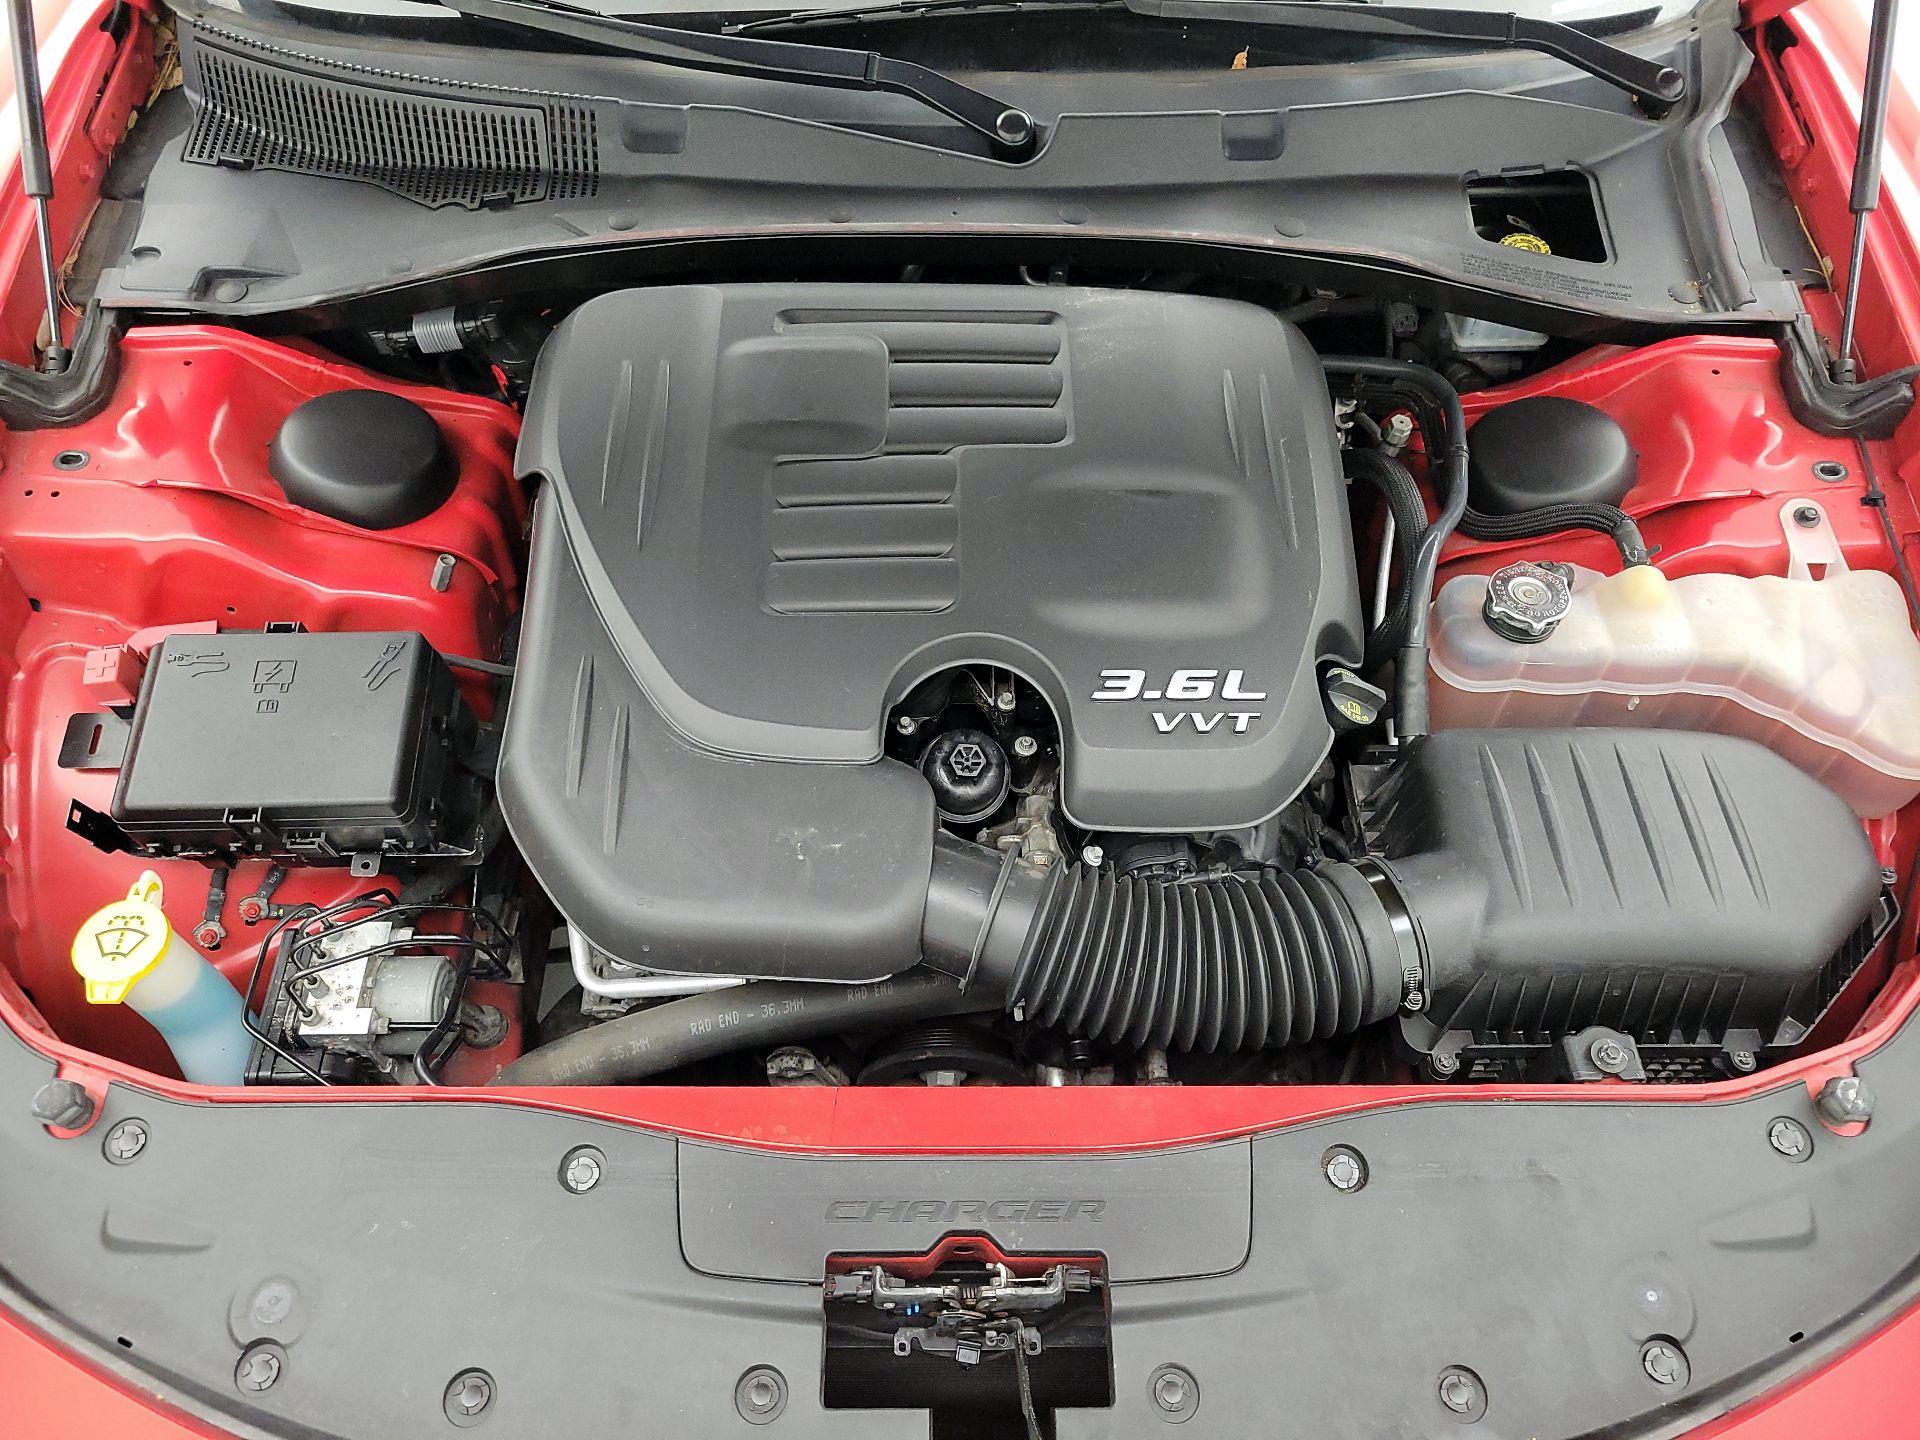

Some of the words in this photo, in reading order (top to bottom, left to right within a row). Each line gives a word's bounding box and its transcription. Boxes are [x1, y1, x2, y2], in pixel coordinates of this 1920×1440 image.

[1090, 669, 1268, 701] 3.6L
[1151, 712, 1261, 735] VVT
[874, 982, 894, 998] END
[690, 1018, 712, 1036] RAD
[718, 1010, 741, 1028] END
[760, 997, 806, 1019] 36.3MM
[824, 1199, 1107, 1224] CHARGER
